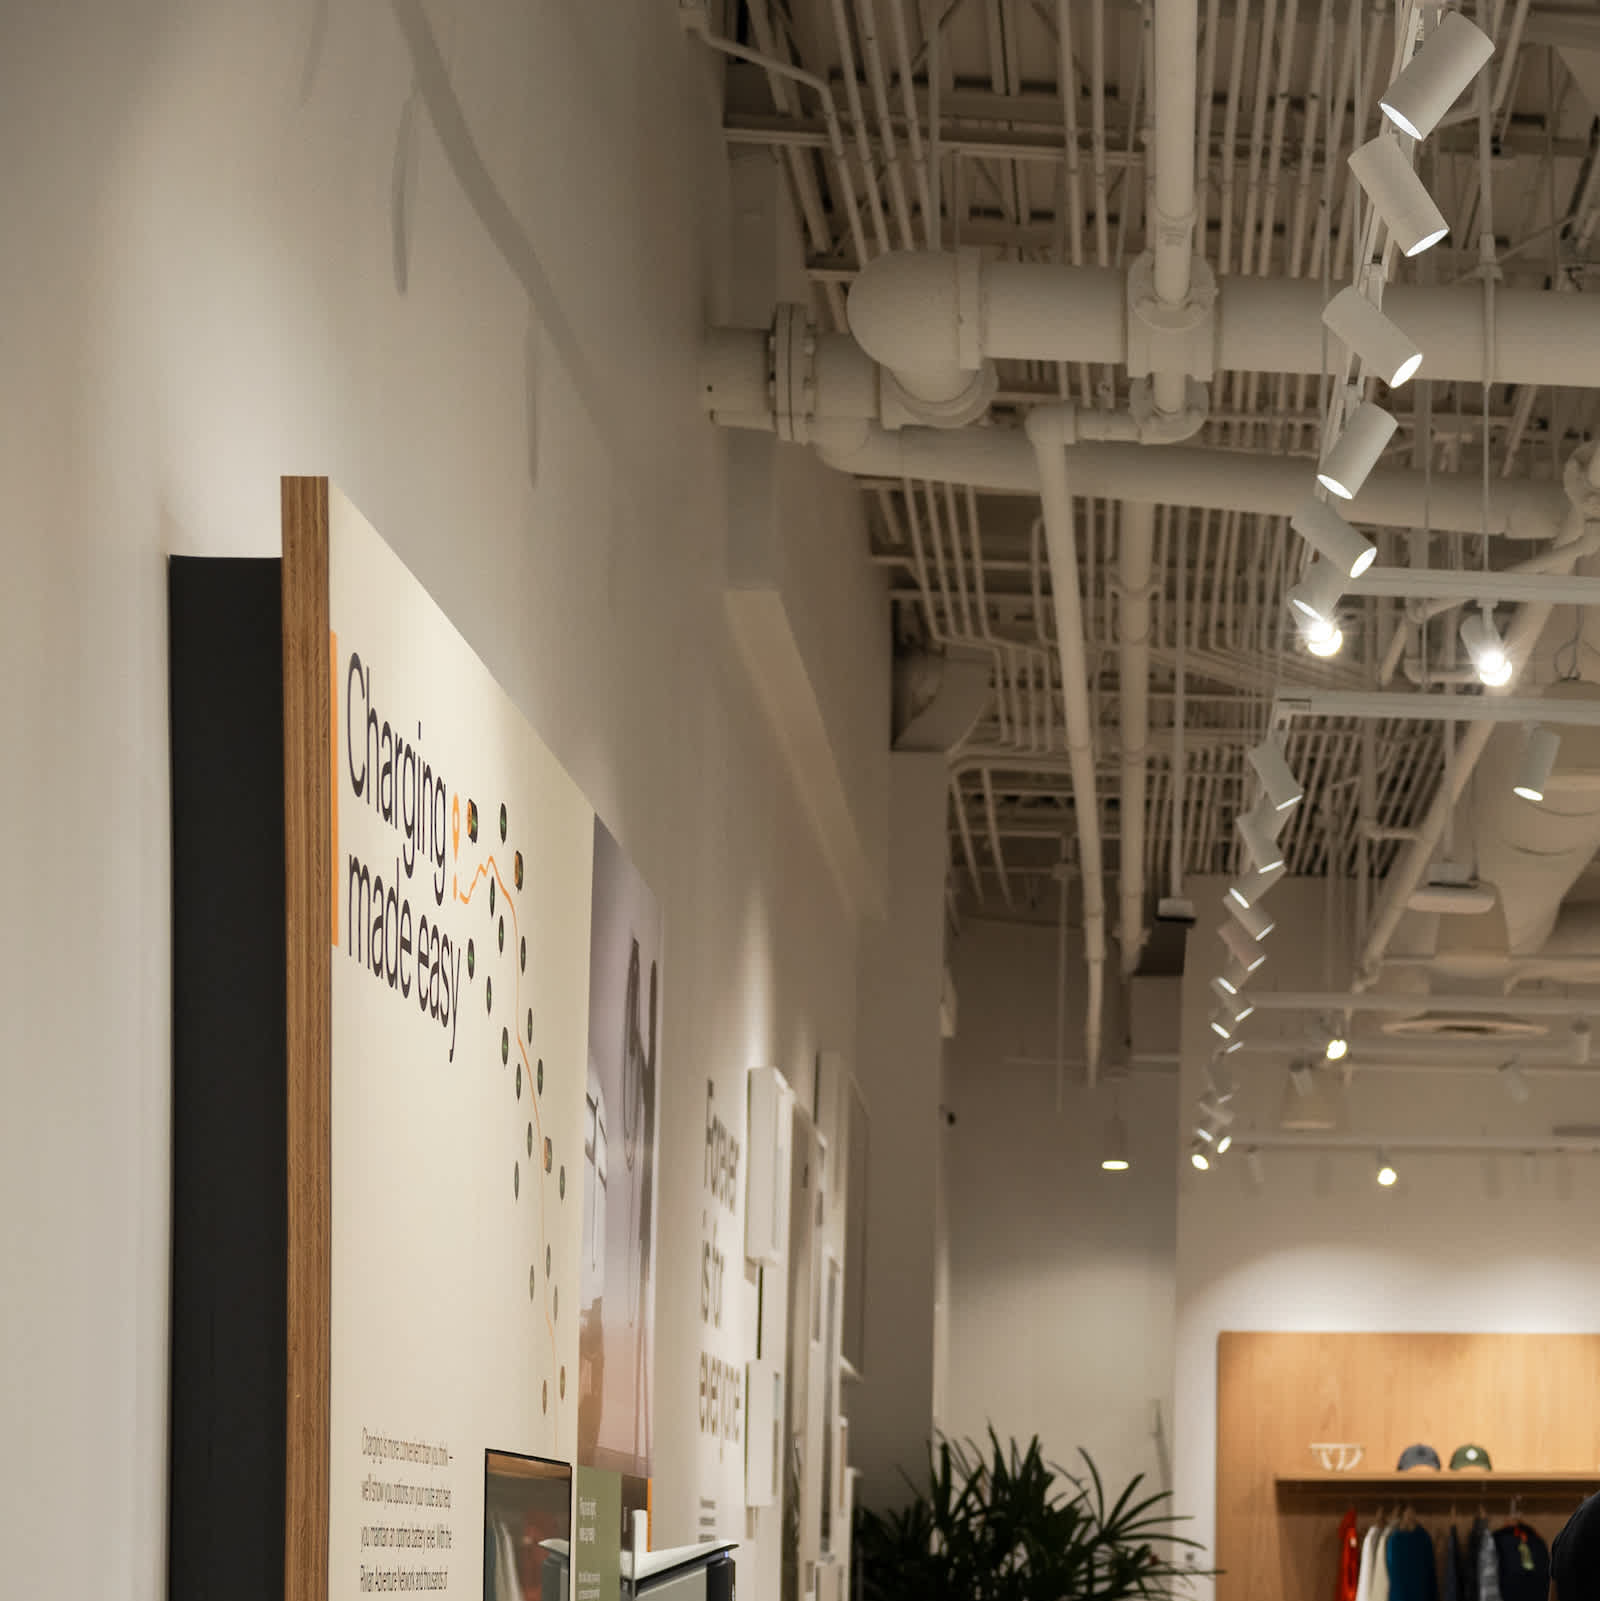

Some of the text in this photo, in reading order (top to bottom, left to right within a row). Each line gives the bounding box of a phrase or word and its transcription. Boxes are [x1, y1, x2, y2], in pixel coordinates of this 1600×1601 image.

[347, 652, 447, 905] Charging
[348, 853, 461, 1062] made easy
